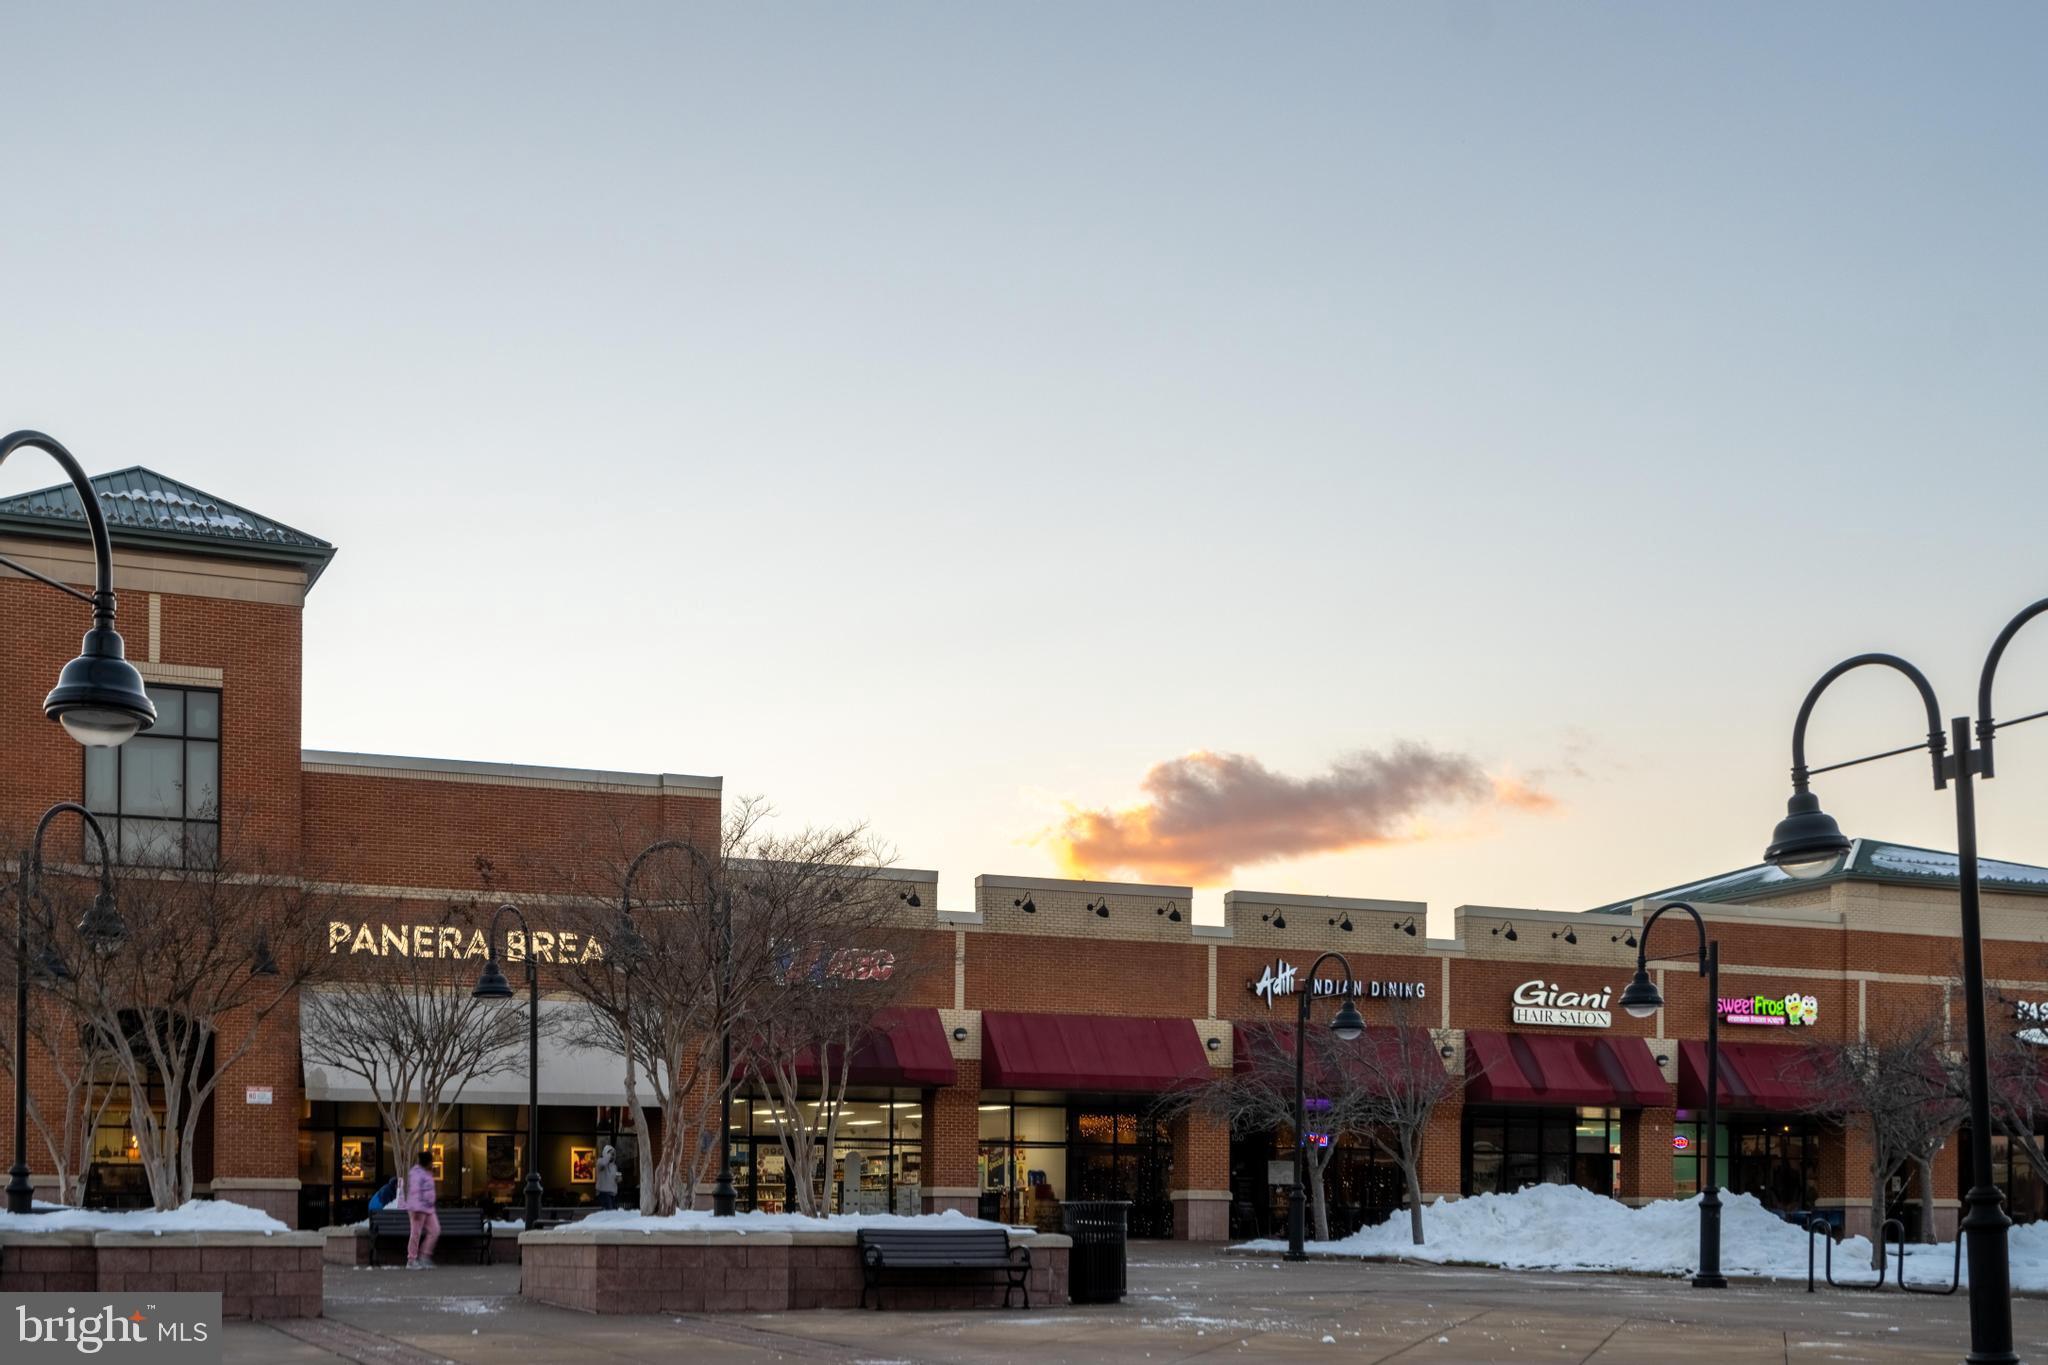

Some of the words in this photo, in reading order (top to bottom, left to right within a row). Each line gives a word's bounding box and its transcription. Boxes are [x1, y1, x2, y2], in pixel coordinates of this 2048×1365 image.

[328, 921, 491, 960] PANERA
[506, 929, 604, 964] BREA
[1371, 980, 1425, 998] DINING
[1513, 980, 1612, 1009] Giani
[1517, 1009, 1554, 1023] HAIR
[1559, 1011, 1608, 1025] SALON
